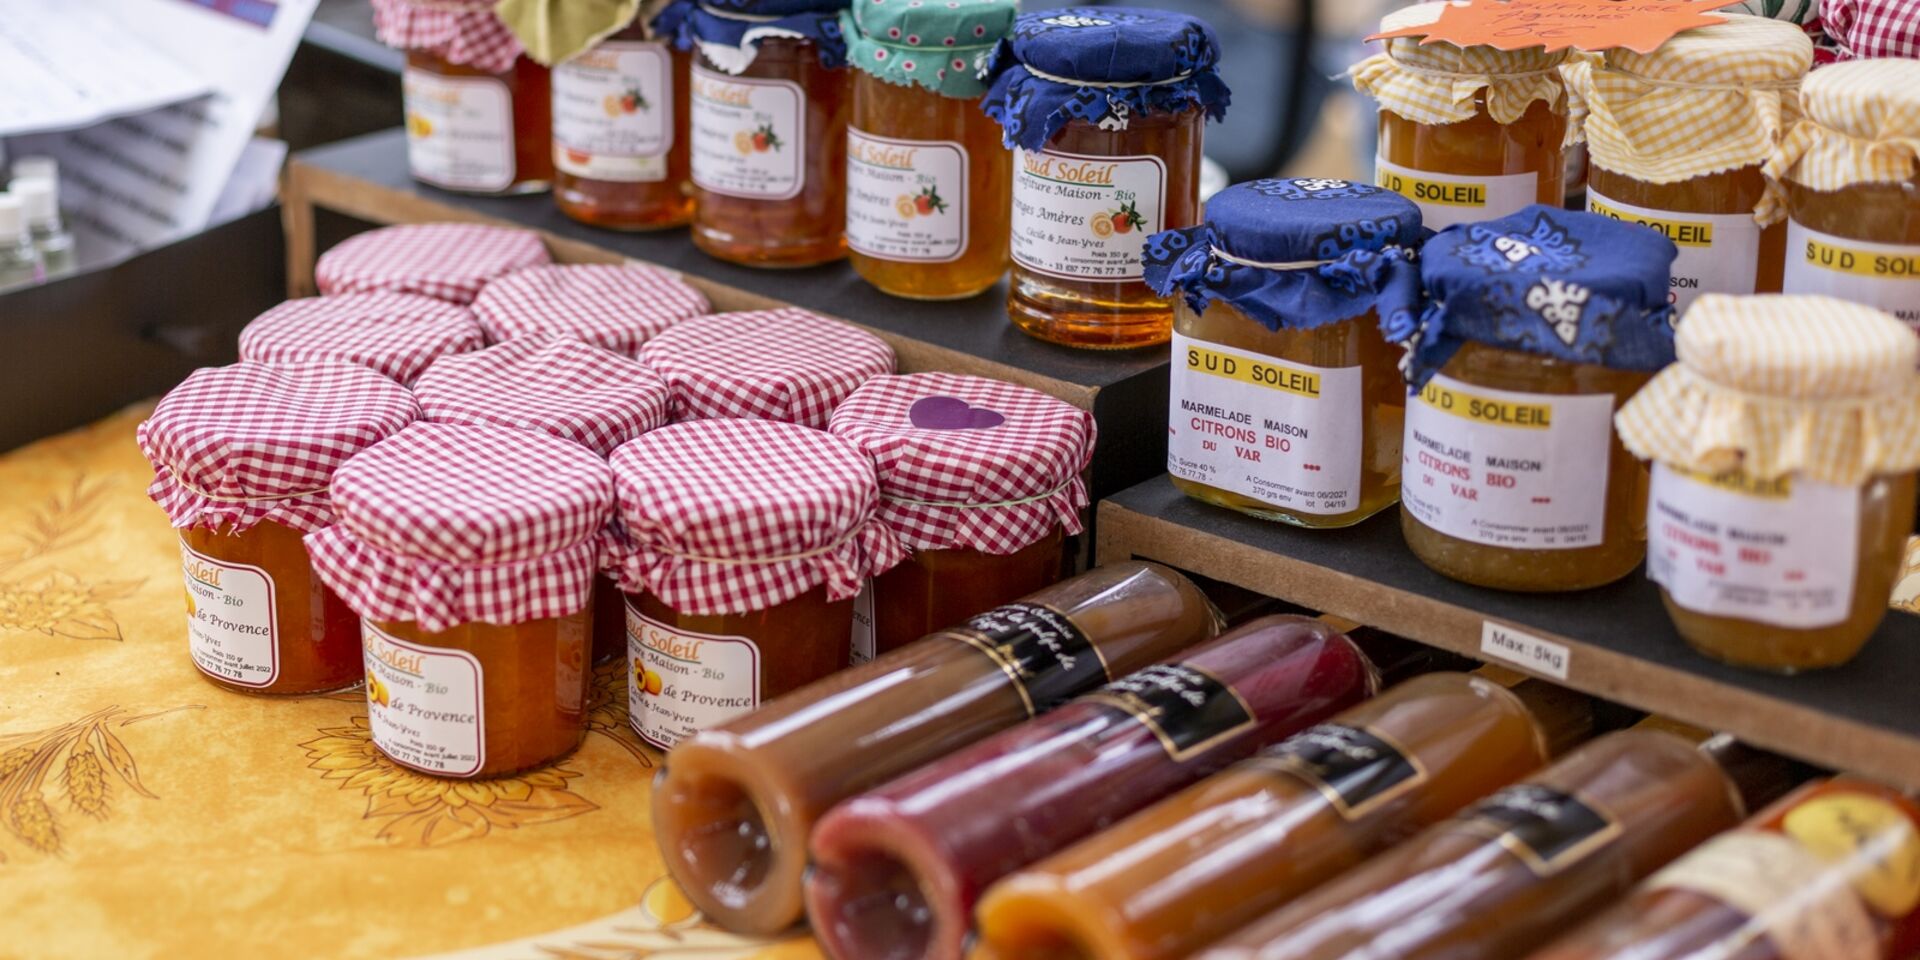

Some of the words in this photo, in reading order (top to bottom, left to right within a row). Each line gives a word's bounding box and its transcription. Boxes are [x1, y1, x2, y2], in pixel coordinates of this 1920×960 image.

[1024, 153, 1055, 177] Sud
[1056, 160, 1118, 184] Soleil
[1054, 185, 1101, 200] Maison
[1114, 190, 1136, 201] Bio
[1415, 183, 1486, 204] SOLEIL
[1037, 207, 1085, 226] Amères
[1056, 235, 1104, 248] Jean-Yves
[1252, 364, 1320, 394] SOLEIL
[1181, 399, 1252, 425] MARMELADE
[1264, 418, 1308, 439] MAISON
[1469, 399, 1551, 425] SOLEIL
[1191, 417, 1256, 444] CITRONS
[1265, 434, 1291, 453] BIO
[1202, 440, 1217, 452] DU
[1235, 446, 1261, 463] VAR
[1413, 429, 1471, 463] MARMELADE
[1486, 456, 1541, 472] MAISON
[1418, 451, 1471, 481] CITRONS
[1486, 473, 1516, 489] BIO
[1253, 476, 1294, 493] Consommer
[1295, 487, 1315, 498] avant
[1450, 484, 1478, 501] VAR
[223, 594, 243, 607] Bio
[210, 614, 269, 637] Provence
[377, 640, 427, 674] Soleil
[648, 629, 704, 660] Soleil
[648, 652, 689, 675] Maison
[702, 667, 725, 681] Bio
[425, 682, 448, 696] Bio
[663, 683, 677, 699] de
[681, 690, 751, 709] Provence
[391, 698, 404, 711] de
[407, 703, 475, 724] Provence
[651, 702, 695, 724] Jean-Yves
